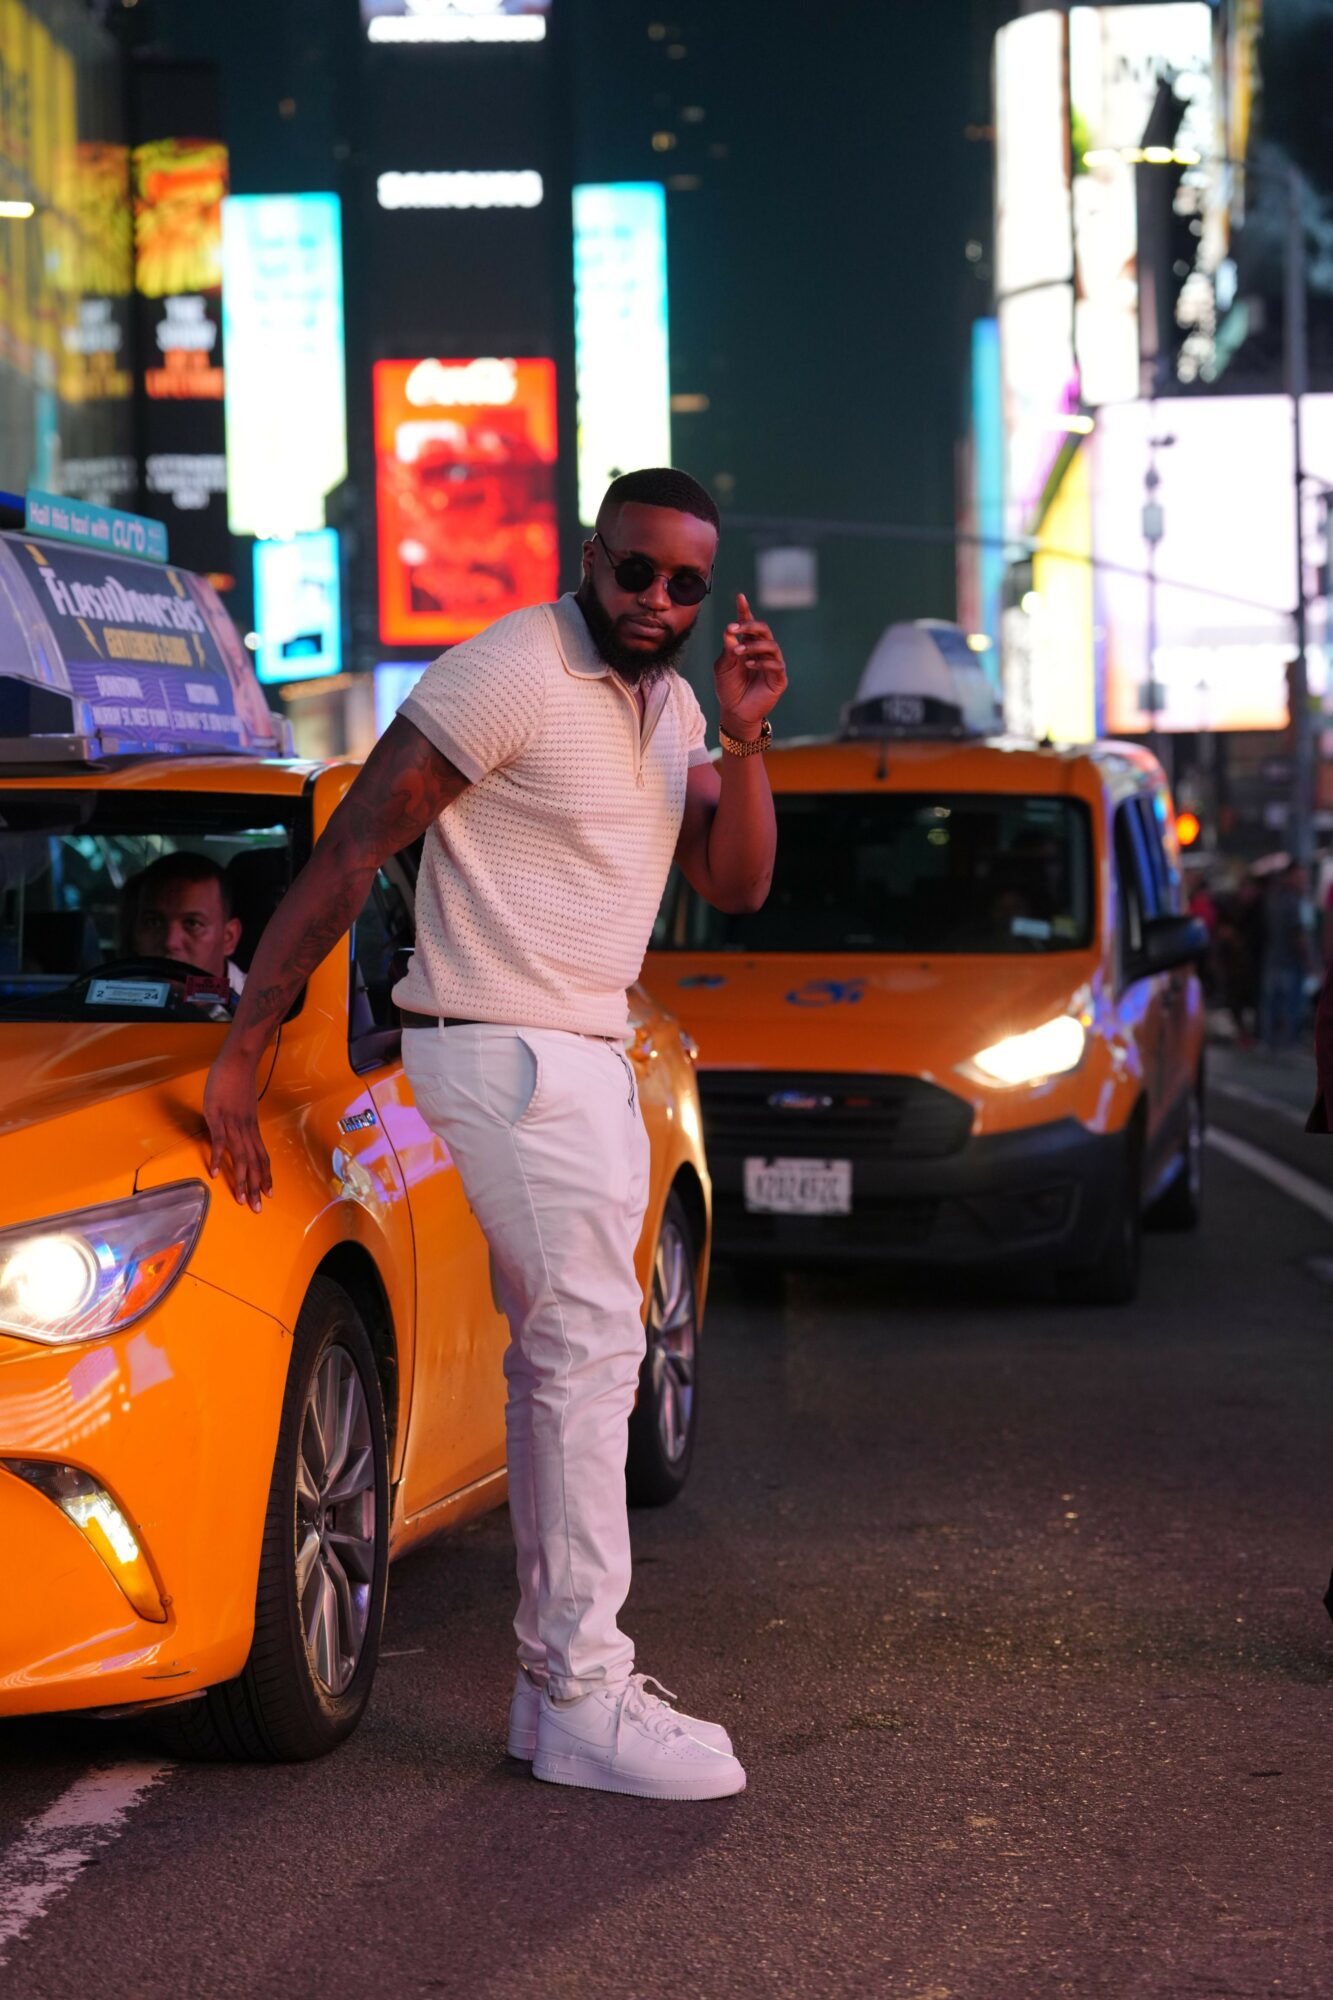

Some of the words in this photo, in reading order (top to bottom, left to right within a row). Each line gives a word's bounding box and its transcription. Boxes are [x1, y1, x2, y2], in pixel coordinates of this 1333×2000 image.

[30, 502, 50, 527] Hail
[52, 507, 69, 532] this
[71, 512, 89, 536] taxi
[91, 517, 109, 540] with
[112, 518, 145, 553] curb
[96, 990, 105, 998] 2
[143, 991, 159, 1000] 24
